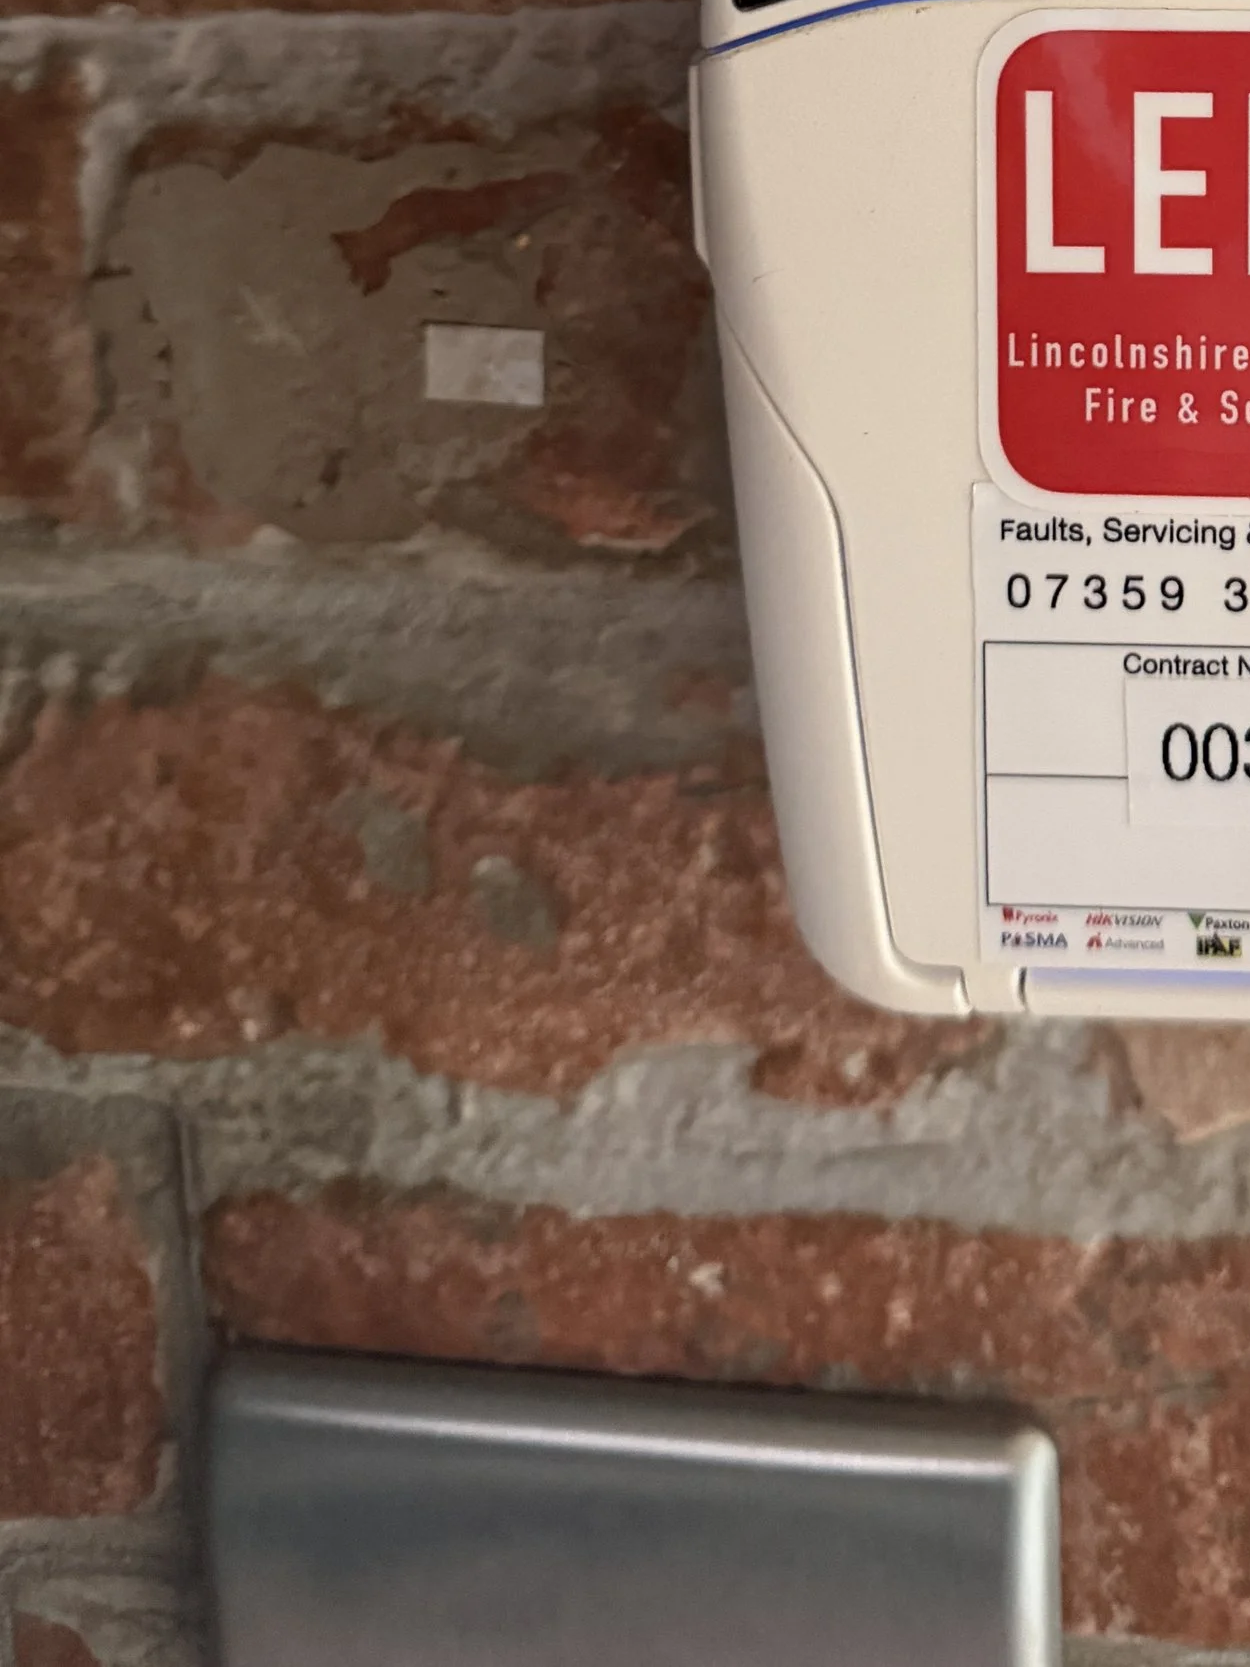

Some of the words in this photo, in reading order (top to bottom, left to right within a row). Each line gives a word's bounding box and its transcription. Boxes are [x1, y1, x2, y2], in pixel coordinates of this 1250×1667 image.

[1007, 332, 1250, 371] Lincolnshire
[1084, 387, 1158, 423] Fire
[1177, 392, 1199, 425] &
[999, 518, 1092, 547] Faults,
[1103, 518, 1236, 551] Servicing
[1006, 573, 1186, 611] 07359
[1122, 653, 1229, 677] Contract
[1205, 916, 1250, 931] Paxton
[1105, 936, 1164, 951] Advanced
